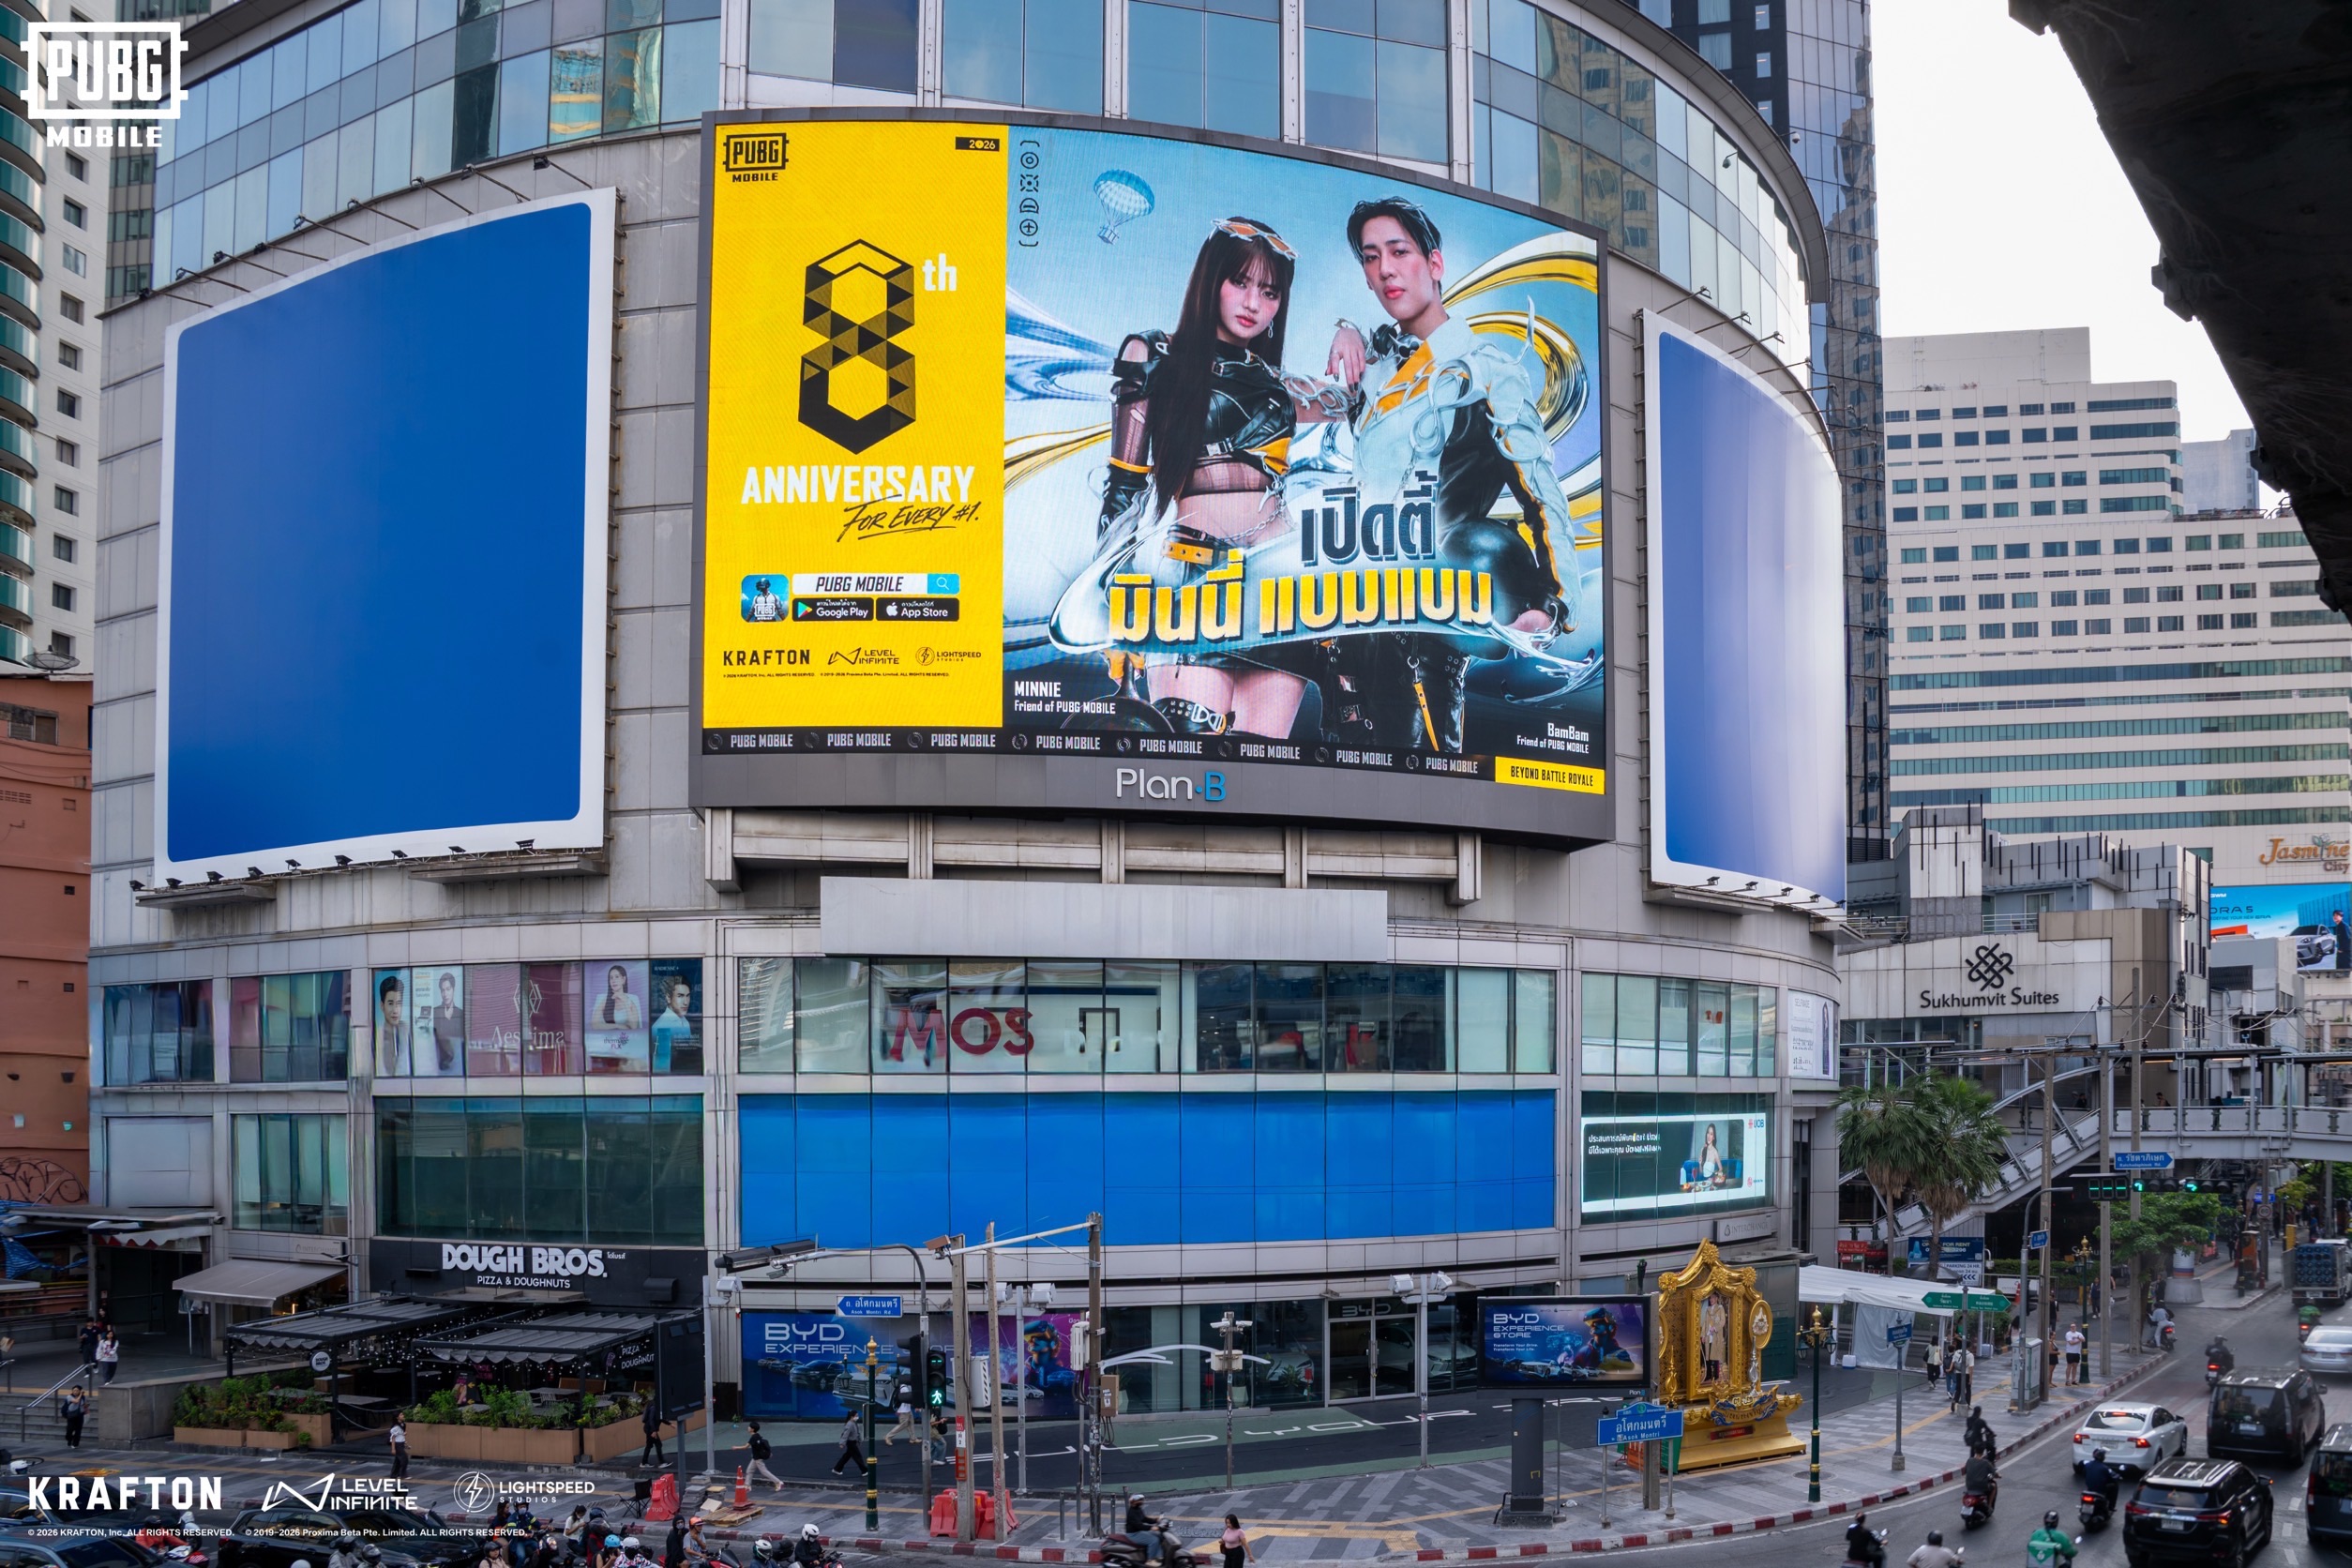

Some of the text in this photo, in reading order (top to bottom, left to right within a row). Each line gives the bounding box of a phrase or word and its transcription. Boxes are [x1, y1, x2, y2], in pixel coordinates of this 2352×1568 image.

[732, 140, 779, 165] PUBG
[969, 140, 996, 150] 2026
[731, 173, 779, 183] MOBILE
[741, 464, 975, 504] ANNIVERSARY
[837, 494, 902, 542] FOR
[888, 504, 956, 531] EVERY
[1301, 470, 1440, 565] เปิดตี้
[816, 576, 904, 592] PUBG MOBILE
[1109, 548, 1493, 643] มินนี่ แบมแบม
[755, 605, 772, 614] PUBG
[817, 605, 868, 618] Google Play
[901, 604, 948, 617] App Store
[723, 649, 809, 666] KRAFTON
[1015, 681, 1062, 698] MINNIE
[1015, 700, 1116, 715] Friend of PUBG MOBILE
[731, 733, 793, 747] PUBG MOBILE
[827, 733, 891, 746] PUBG MOBILE
[931, 733, 996, 747] PUBG MOBILE
[1547, 722, 1589, 742] BamBam
[1036, 735, 1100, 750] PUBG MOBILE
[1139, 739, 1202, 754] PUBG MOBILE
[1516, 735, 1589, 754] Friend of PUBG MOBILE
[1240, 744, 1300, 760] PUBG MOBILE
[1336, 749, 1393, 766] PUBG MOBILE
[1425, 757, 1478, 774] PUBG MOBILE
[1511, 765, 1593, 787] BEYOND BATTLE ROYALE
[2323, 861, 2351, 874] City
[1920, 987, 2059, 1009] Sukhumvit Suites
[1754, 1119, 1764, 1128] UOB
[442, 1244, 608, 1278] DOUGH BROS.
[477, 1275, 571, 1289] PIZZA & DOUGHNUTS
[855, 1297, 897, 1307] อโศกมนตรี
[1493, 1313, 1540, 1324] BYD
[765, 1323, 844, 1341] BYD
[623, 1345, 640, 1356] PIZZA
[1616, 1415, 1666, 1433] อโศกมนตรี
